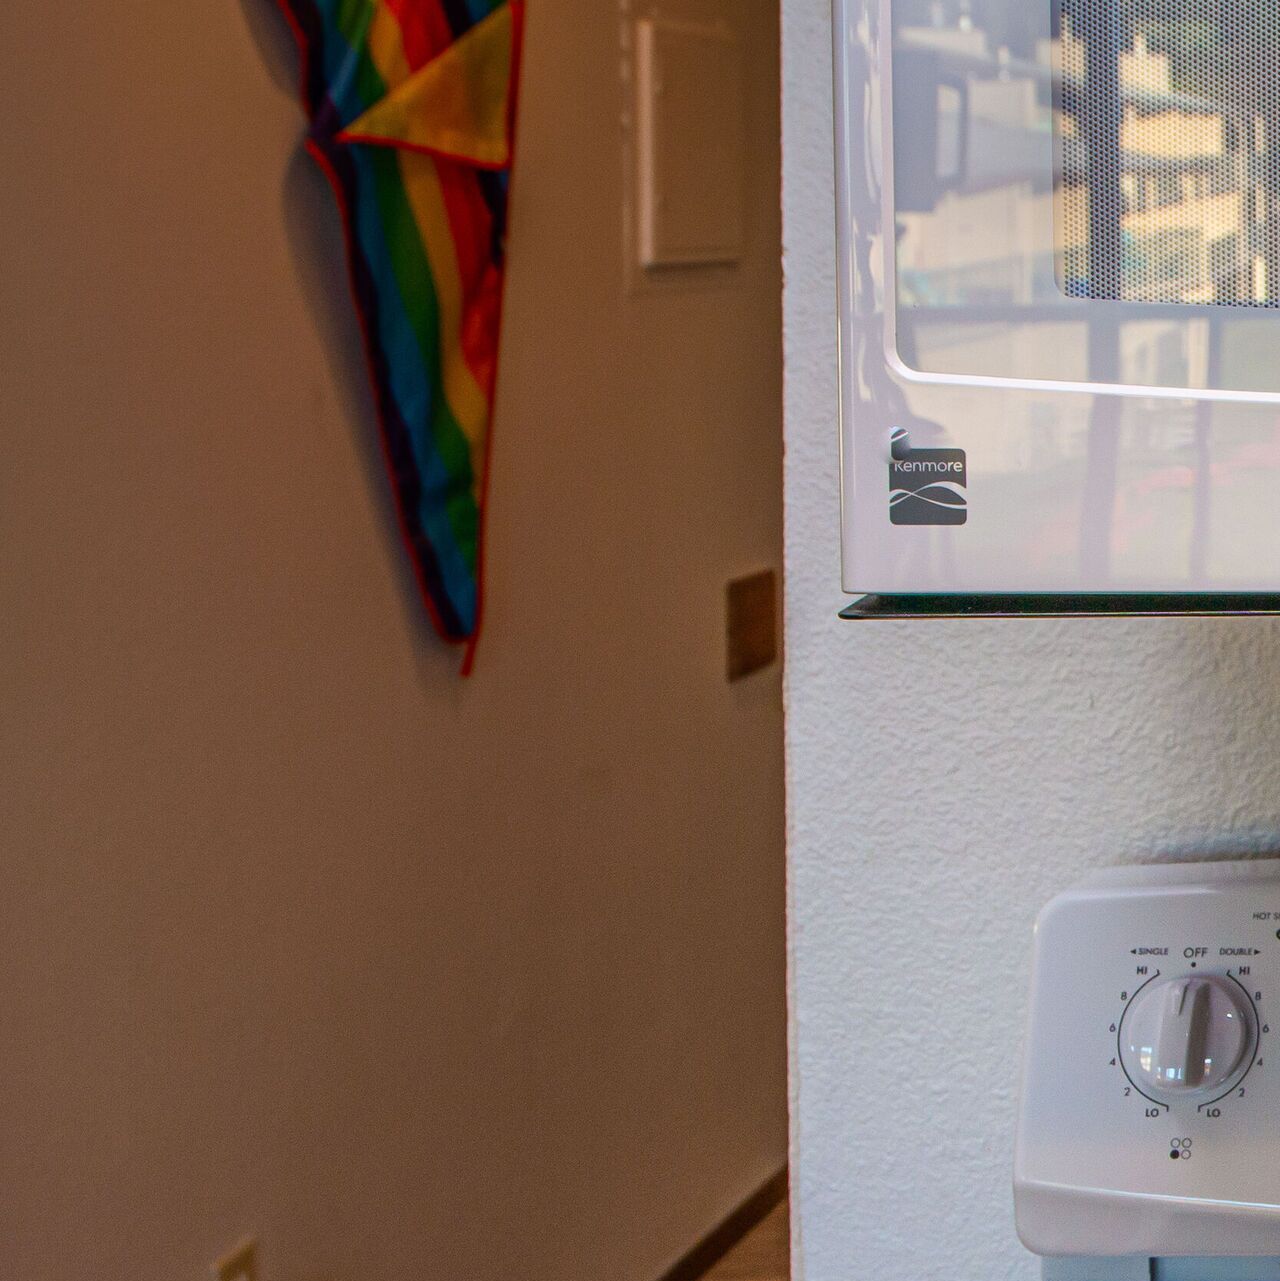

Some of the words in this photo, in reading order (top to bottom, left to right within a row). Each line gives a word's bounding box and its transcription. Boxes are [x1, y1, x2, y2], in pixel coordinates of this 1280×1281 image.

[894, 461, 963, 472] Kenmore
[1252, 912, 1270, 920] HOT
[1138, 948, 1169, 956] SINGLE
[1183, 948, 1209, 959] OFF
[1219, 948, 1253, 956] DOUBLE
[1136, 966, 1148, 975] HI
[1239, 966, 1250, 975] HI
[1120, 992, 1128, 1001] 8
[1254, 991, 1262, 1001] 8
[1109, 1024, 1116, 1033] 6
[1262, 1024, 1270, 1033] 6
[1109, 1058, 1116, 1067] 4
[1257, 1058, 1263, 1067] 4
[1123, 1087, 1131, 1096] 2
[1238, 1088, 1245, 1097] 2
[1145, 1109, 1159, 1118] LO
[1207, 1109, 1221, 1118] LO
